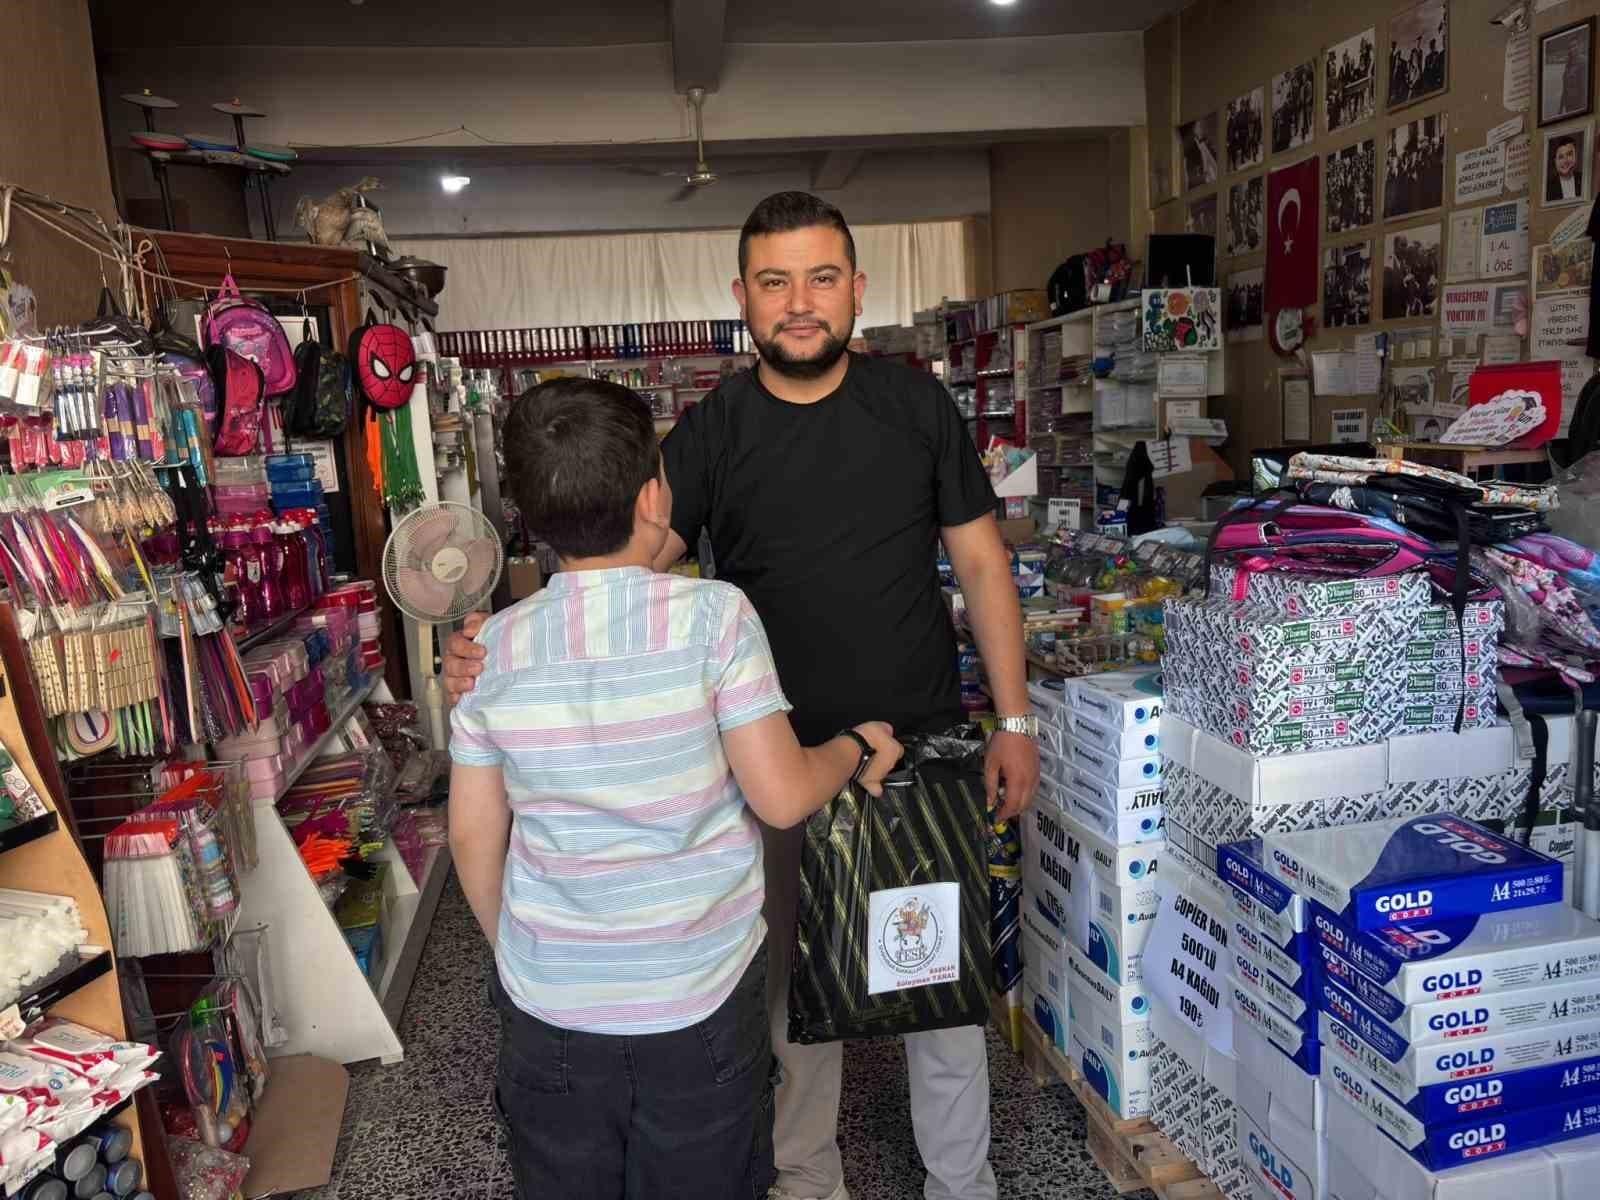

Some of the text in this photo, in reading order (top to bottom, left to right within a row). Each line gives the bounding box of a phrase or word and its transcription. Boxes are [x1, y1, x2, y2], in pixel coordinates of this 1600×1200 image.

[1131, 790, 1165, 810] AILY
[1412, 822, 1507, 865] GOLD
[1226, 857, 1250, 880] GOLD
[1274, 850, 1299, 873] GOLD
[1376, 889, 1433, 913] GOLD
[1491, 881, 1511, 902] A4
[1389, 907, 1433, 922] COPY
[1209, 917, 1228, 948] BON
[1236, 923, 1258, 946] GOLD
[1316, 915, 1344, 942] GOLD
[1170, 958, 1185, 981] A4
[1236, 955, 1260, 979] GOLD
[1422, 969, 1483, 993] GOLD
[1542, 960, 1561, 980] A4
[1234, 989, 1257, 1013] GOLD
[1324, 986, 1353, 1014] GOLD
[1427, 1008, 1490, 1031] GOLD
[1549, 999, 1569, 1019] A4
[1329, 1022, 1358, 1051] GOLD
[1435, 1048, 1495, 1071] GOLD
[1552, 1037, 1572, 1058] A4
[1334, 1065, 1363, 1096] GOLD
[1444, 1079, 1504, 1105] GOLD
[1560, 1066, 1580, 1088] A4
[1449, 1123, 1506, 1150] GOLD
[1562, 1108, 1582, 1131] A4
[1249, 1132, 1293, 1190] GOLD
